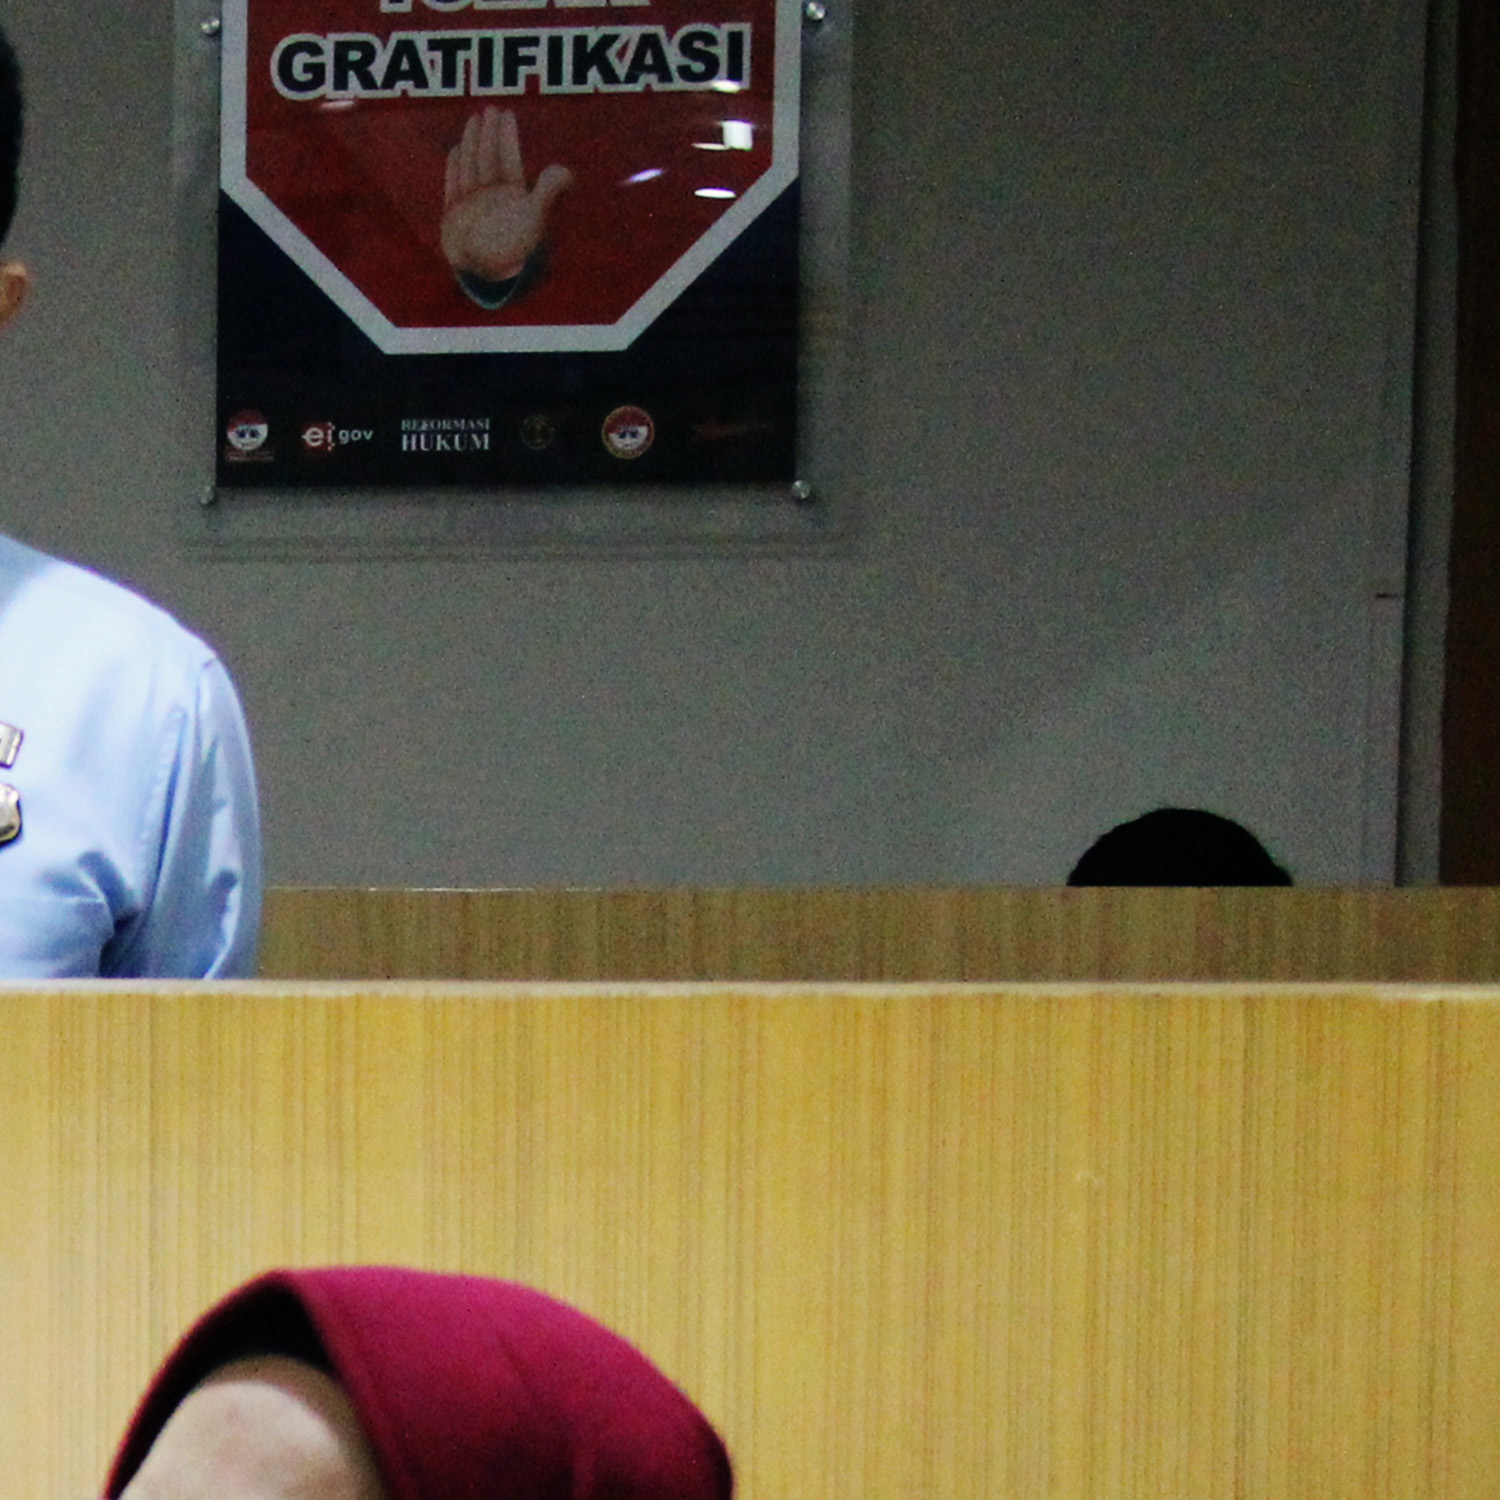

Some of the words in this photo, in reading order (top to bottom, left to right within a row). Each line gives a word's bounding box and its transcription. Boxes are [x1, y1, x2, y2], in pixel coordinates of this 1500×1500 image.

[274, 26, 748, 96] GRATIFIKASI
[401, 418, 490, 432] REFORMASI
[401, 433, 490, 451] HUKUM
